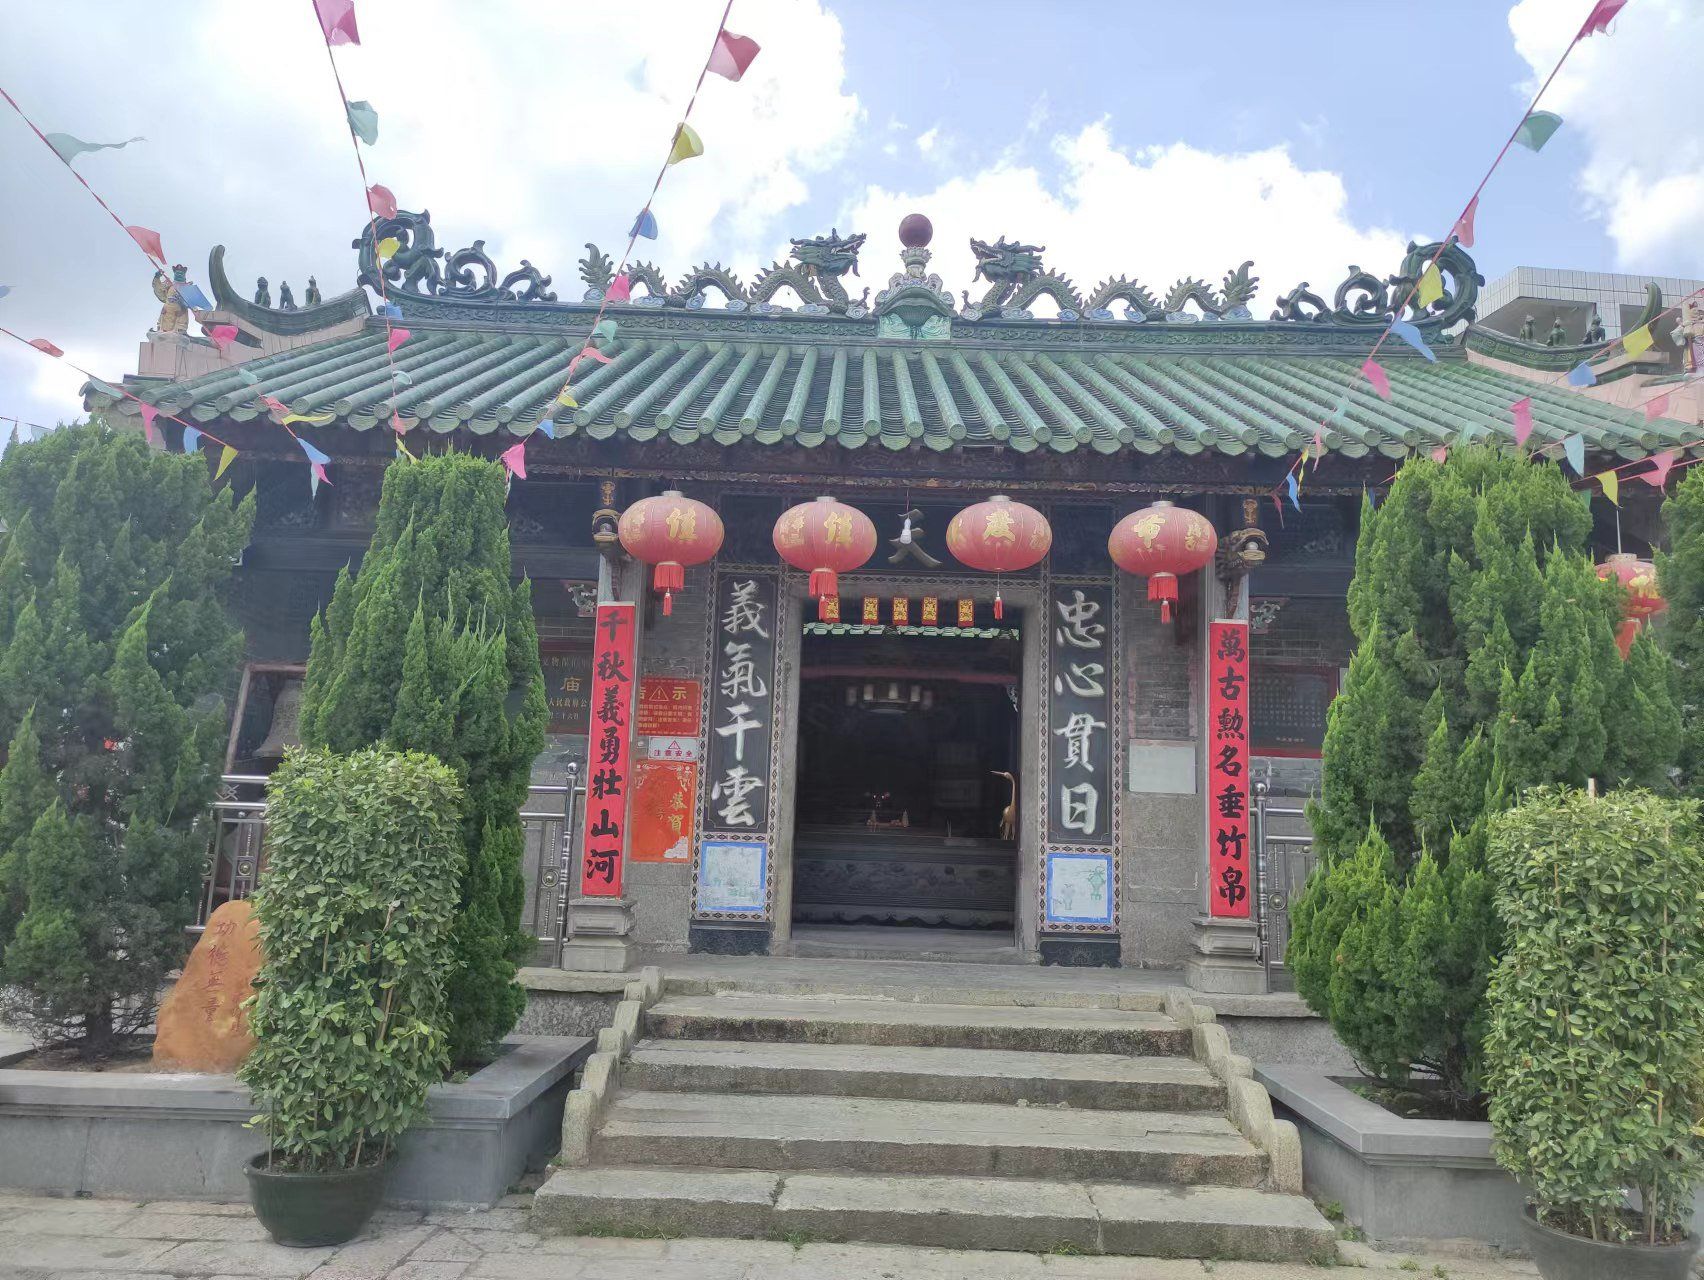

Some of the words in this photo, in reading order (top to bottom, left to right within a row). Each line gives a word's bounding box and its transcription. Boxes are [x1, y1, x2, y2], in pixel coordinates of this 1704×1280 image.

[653, 749, 693, 758] 注意安全
[1053, 589, 1106, 835] 忠心貫日
